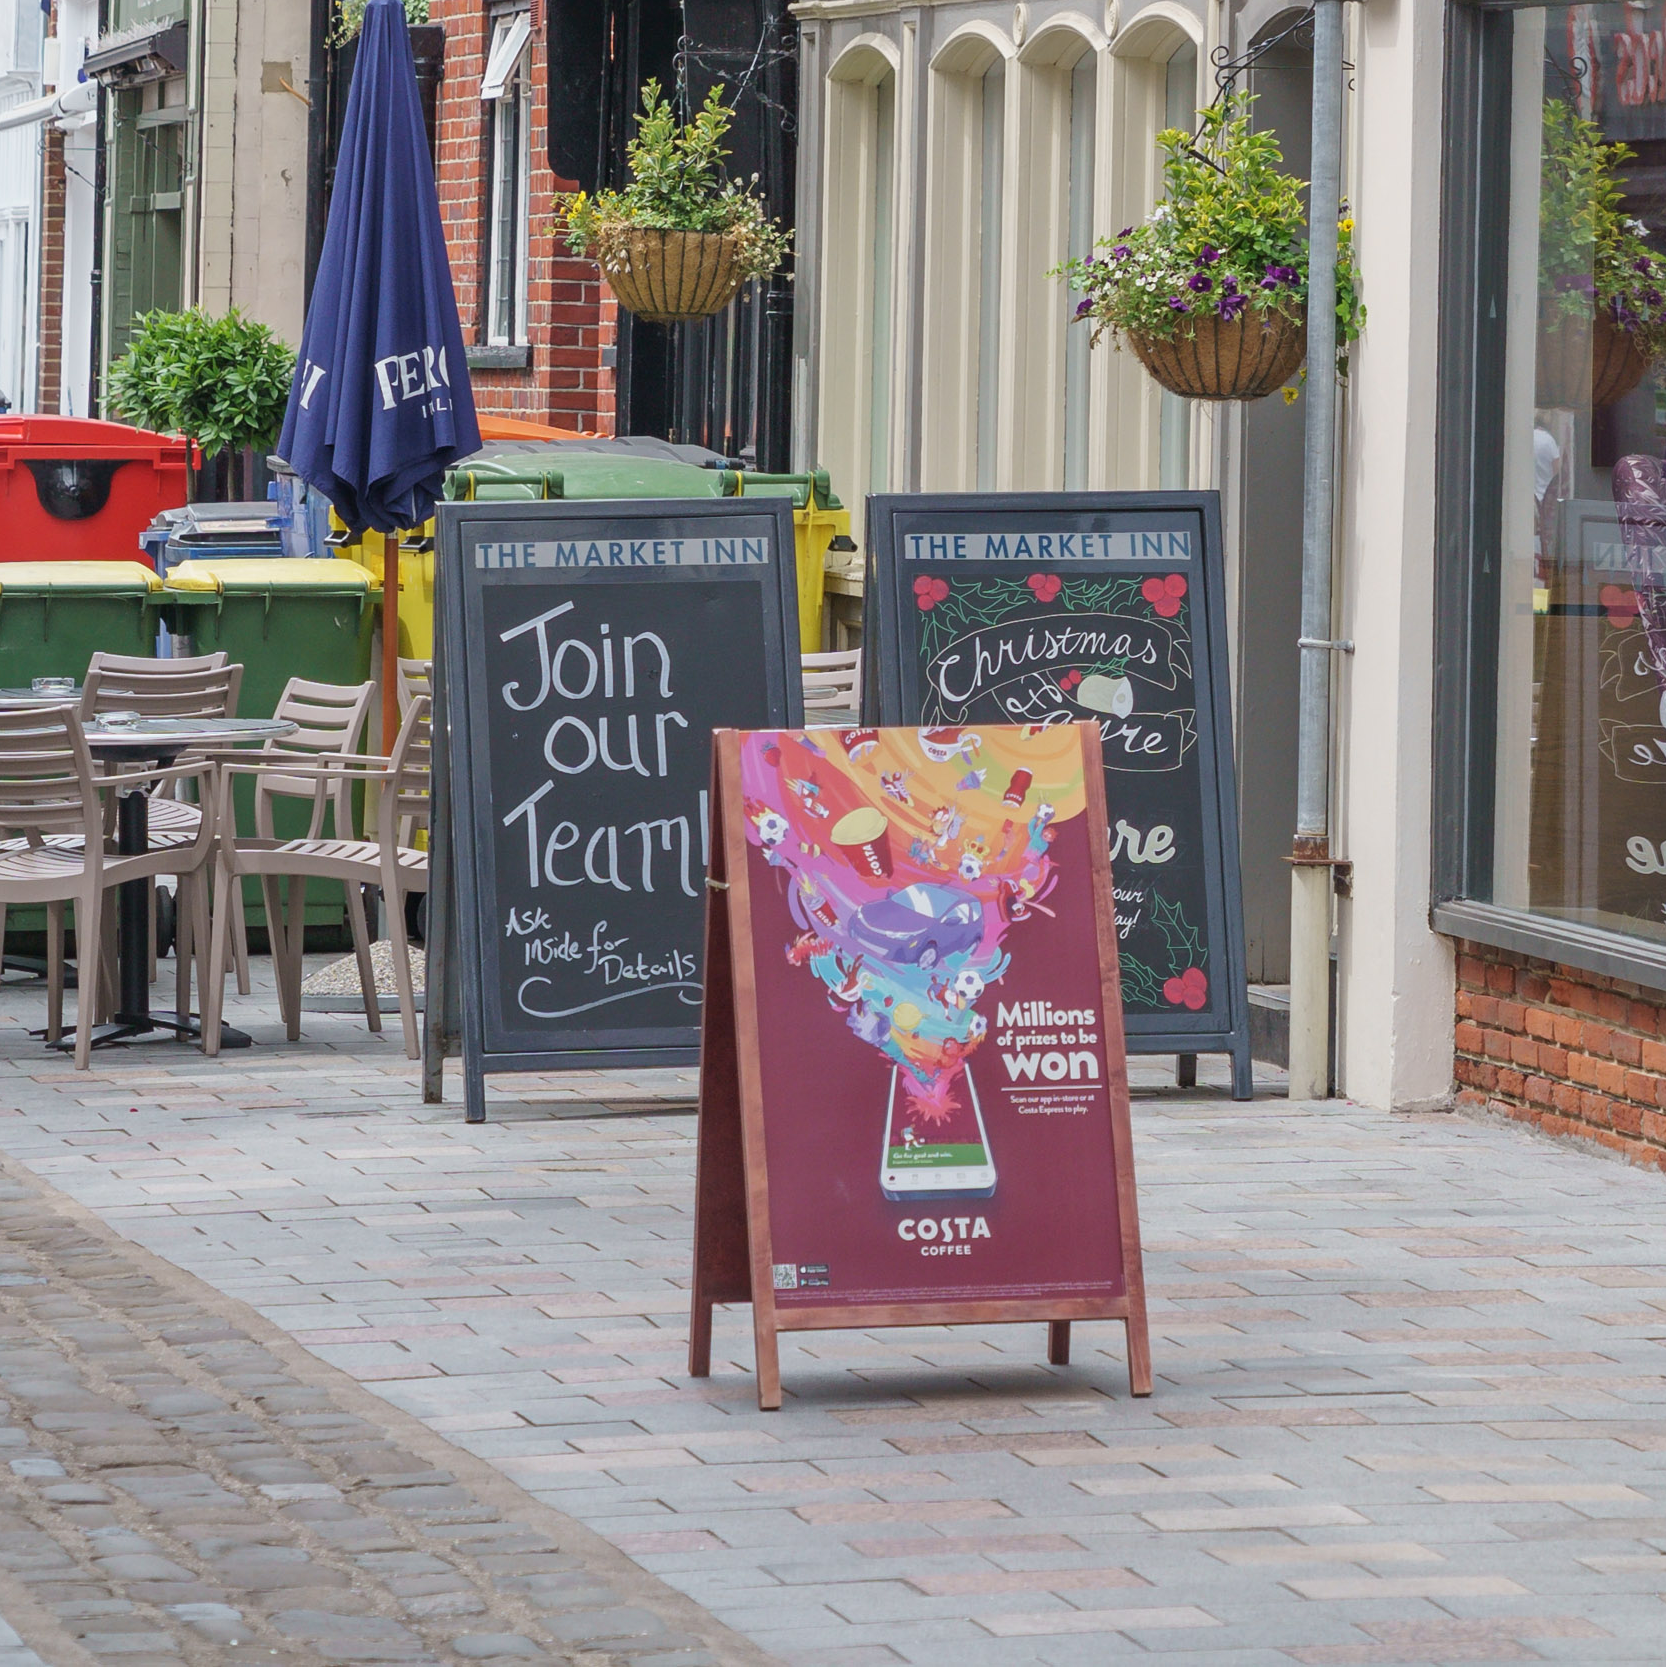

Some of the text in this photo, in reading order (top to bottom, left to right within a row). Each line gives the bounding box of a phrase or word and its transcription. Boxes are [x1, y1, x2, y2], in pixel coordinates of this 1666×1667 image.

[478, 537, 765, 570] THE MARKET INN
[909, 532, 1191, 560] THE MARKET INN
[499, 600, 673, 712] Join
[939, 626, 1158, 704] Christmas
[542, 710, 688, 778] our
[927, 746, 948, 757] COSTA
[862, 843, 882, 877] COSTA
[506, 907, 552, 939] Ask
[583, 920, 629, 974] for
[602, 947, 697, 987] Details
[996, 1001, 1096, 1028] Millions
[996, 1027, 1098, 1052] of prizes to be
[1001, 1050, 1100, 1082] won
[1018, 1105, 1038, 1114] Costa
[1038, 1104, 1065, 1115] Express
[897, 1216, 991, 1243] COSTA
[920, 1244, 972, 1257] COFFEE
